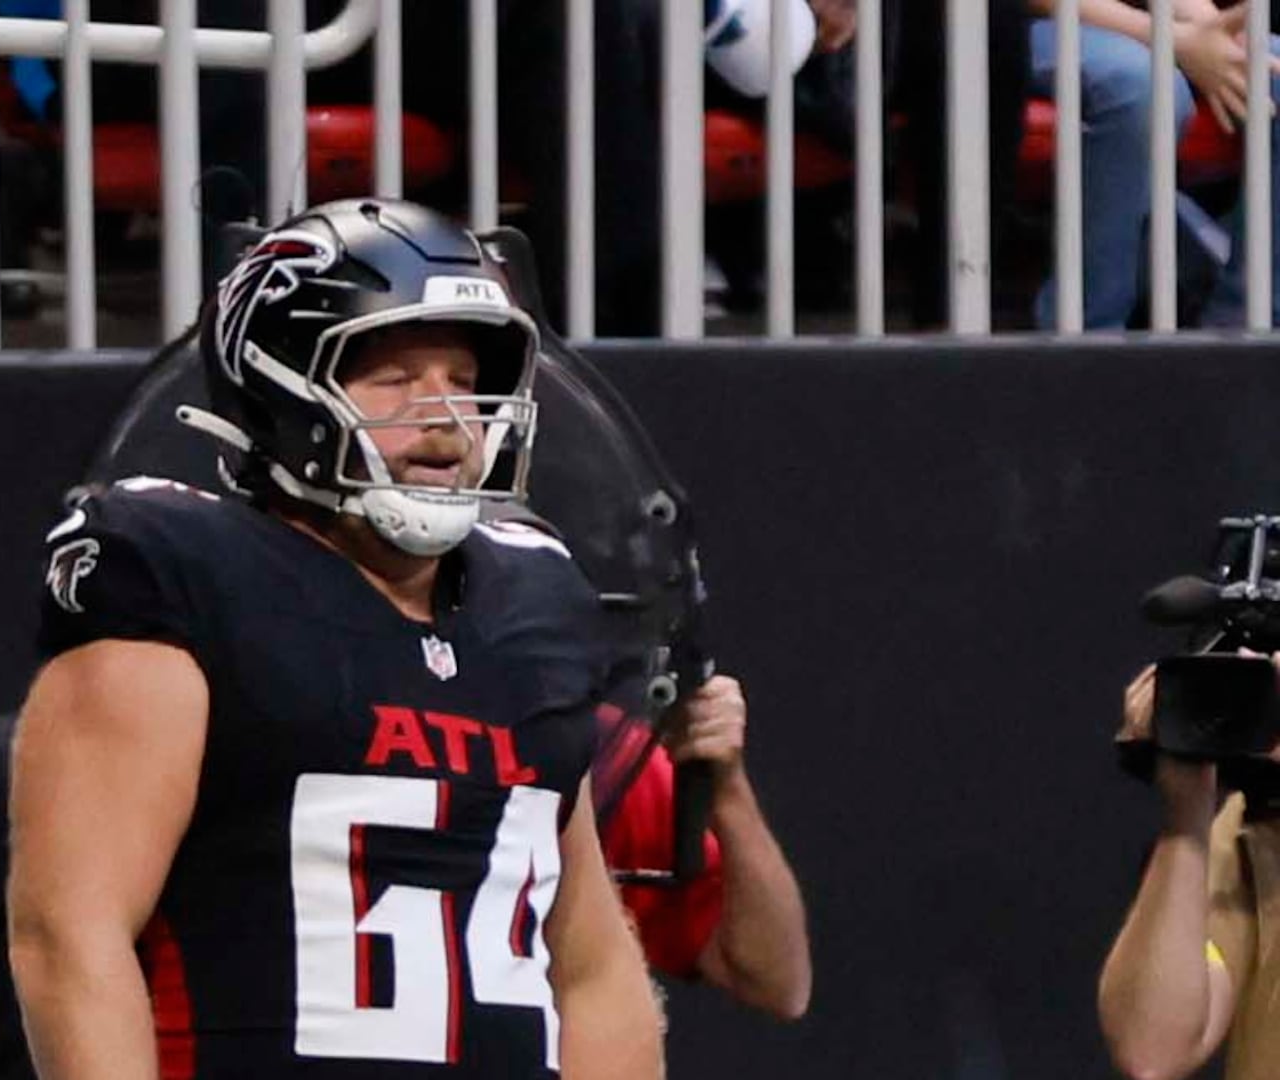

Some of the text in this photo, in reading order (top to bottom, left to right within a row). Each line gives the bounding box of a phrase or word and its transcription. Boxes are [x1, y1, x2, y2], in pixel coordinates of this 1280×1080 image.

[455, 283, 496, 301] ATL
[365, 704, 537, 787] ATL
[290, 772, 562, 1071] 64
